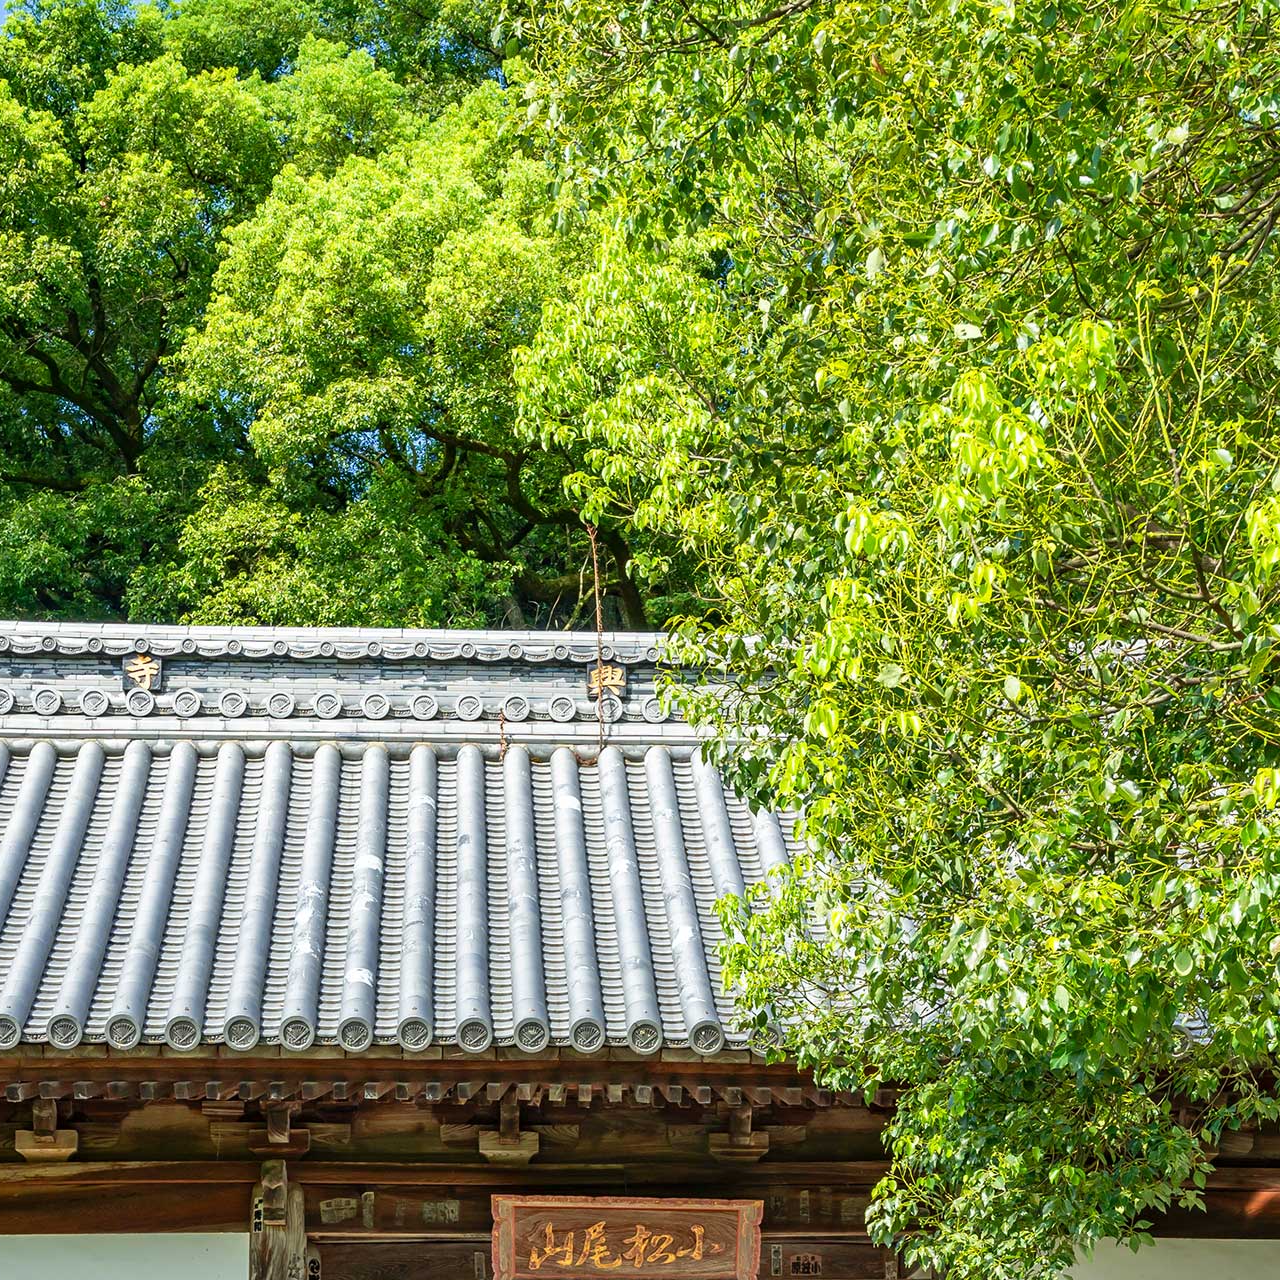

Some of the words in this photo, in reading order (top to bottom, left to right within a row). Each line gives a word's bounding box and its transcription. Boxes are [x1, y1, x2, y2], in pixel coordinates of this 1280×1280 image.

[126, 653, 160, 690] 寺
[588, 665, 626, 696] 興
[527, 1220, 724, 1271] 小松尾山
